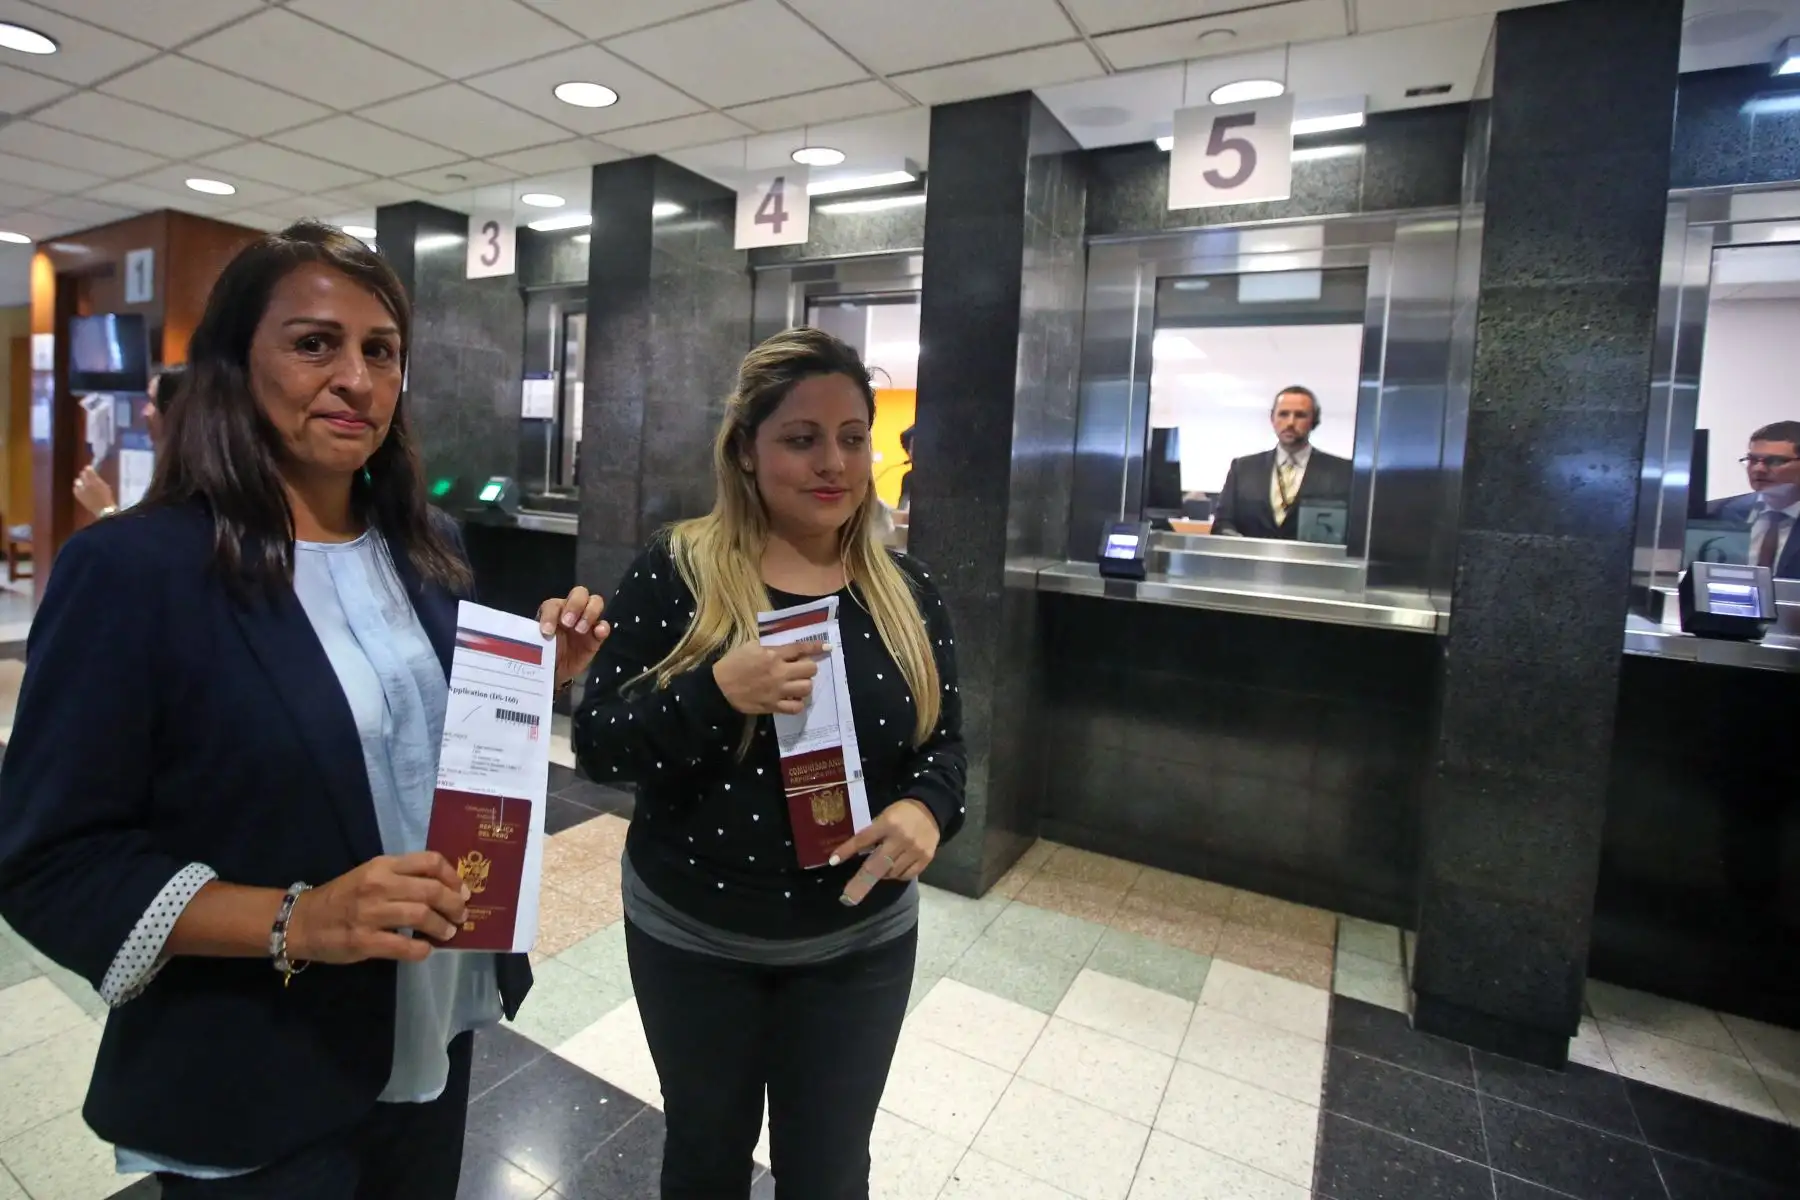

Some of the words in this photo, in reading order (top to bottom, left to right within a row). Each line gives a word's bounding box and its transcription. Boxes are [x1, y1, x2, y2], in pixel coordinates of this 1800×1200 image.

[1202, 111, 1257, 190] 5
[754, 176, 788, 234] 4
[481, 220, 501, 267] 3
[134, 258, 144, 296] 1
[1316, 512, 1334, 537] 5
[1698, 536, 1728, 564] 6
